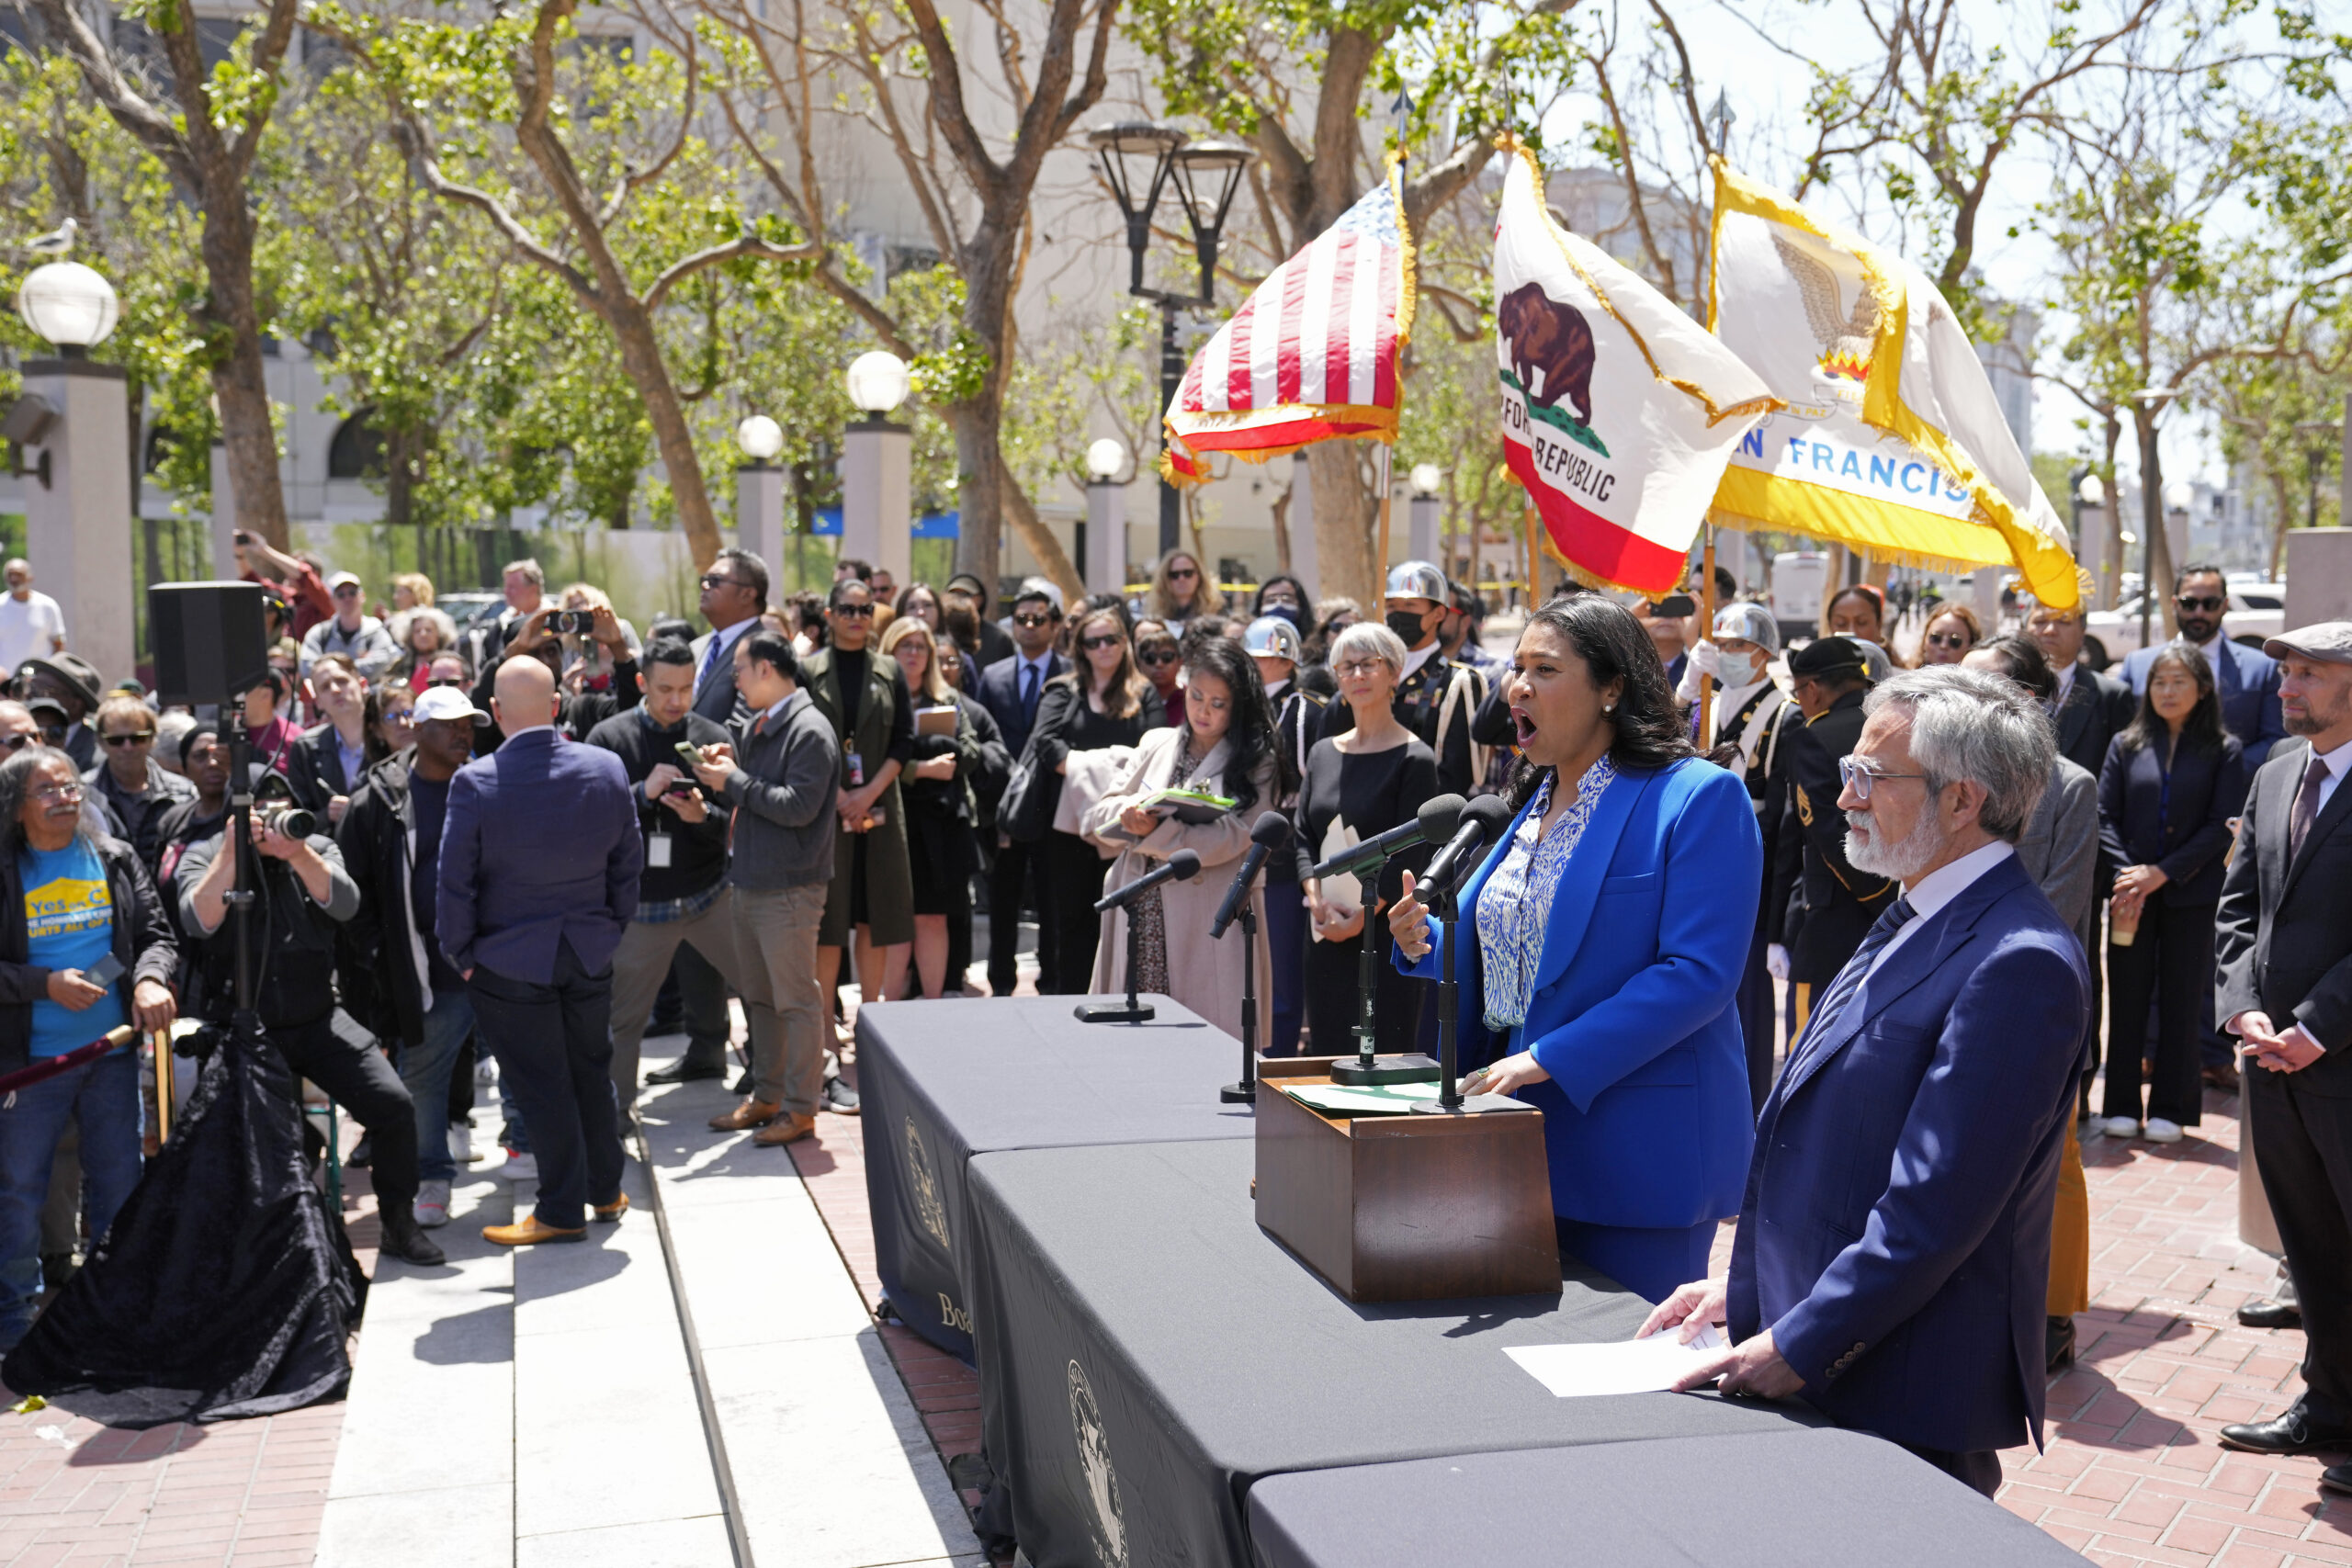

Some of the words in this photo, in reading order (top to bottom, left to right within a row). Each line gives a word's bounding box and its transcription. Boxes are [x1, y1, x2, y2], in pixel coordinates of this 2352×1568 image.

[1805, 407, 1826, 418] PAZ
[1535, 436, 1615, 502] REPUBLIC
[31, 899, 66, 914] Yes
[89, 889, 105, 904] C
